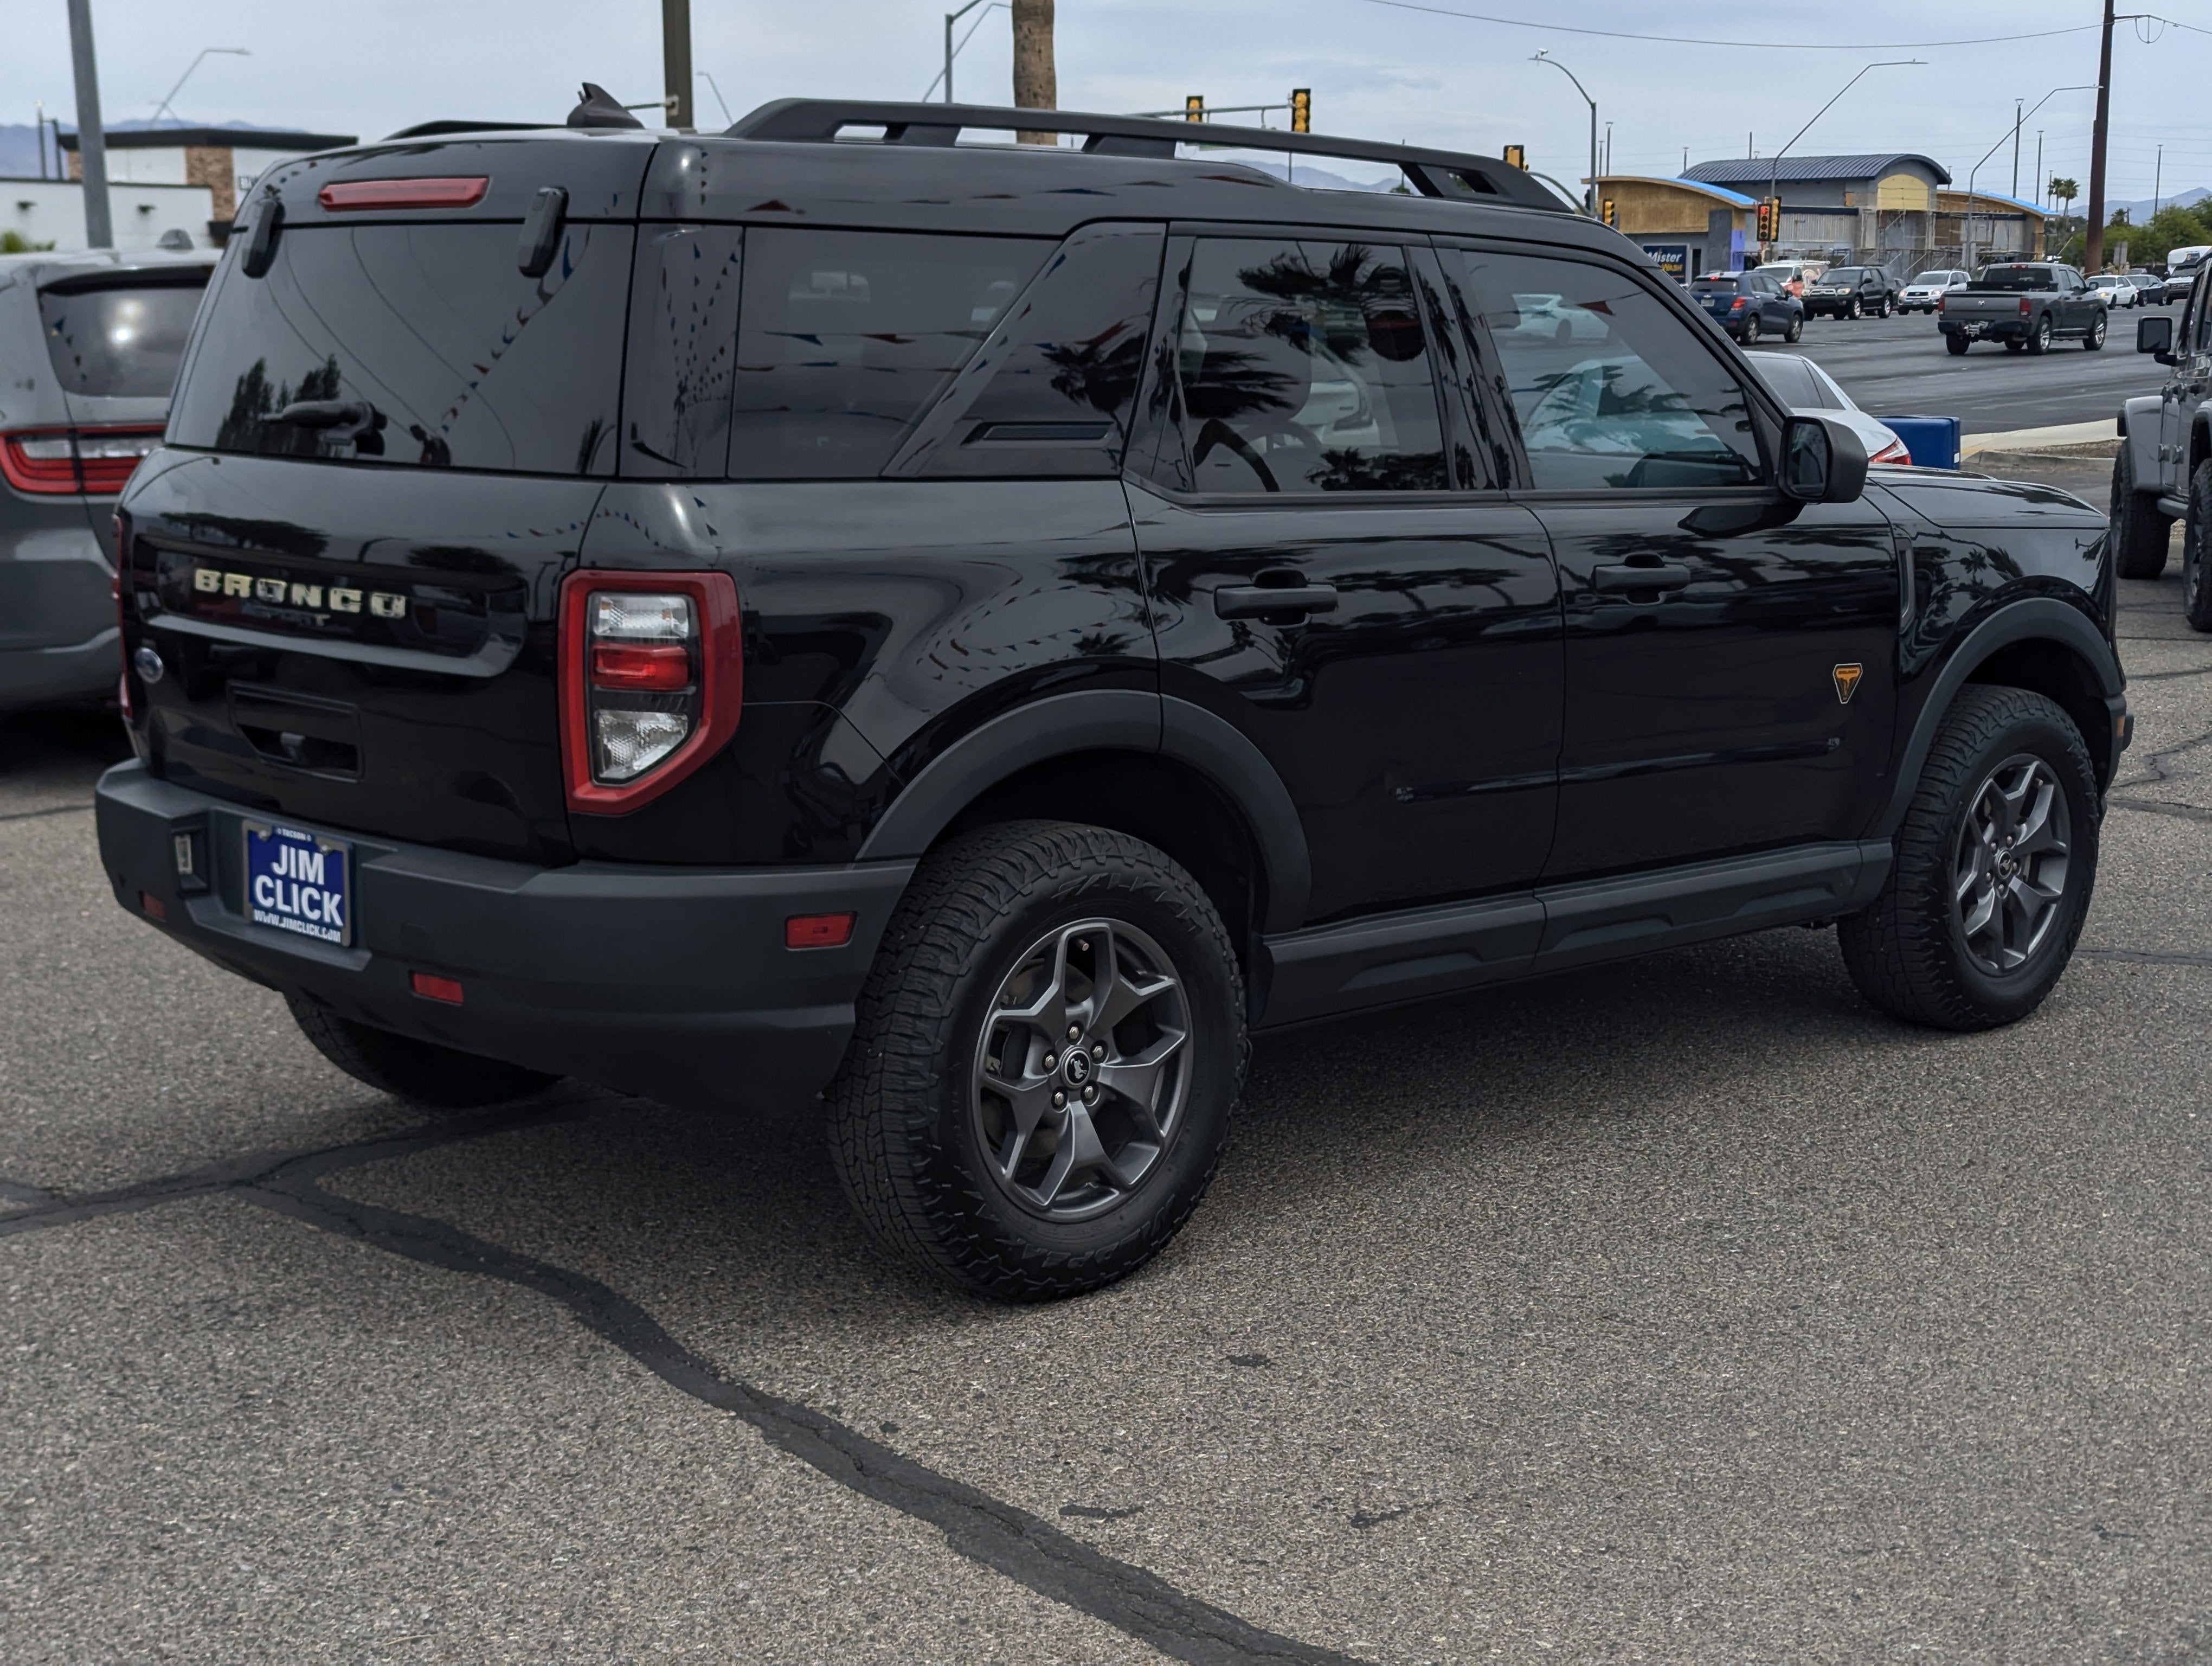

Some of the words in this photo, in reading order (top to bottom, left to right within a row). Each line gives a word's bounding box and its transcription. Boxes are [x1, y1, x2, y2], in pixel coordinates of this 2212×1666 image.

[1648, 252, 1682, 262] Mister
[194, 568, 407, 618] BRONCO
[272, 844, 324, 885] JIM
[255, 874, 344, 927] CLICK
